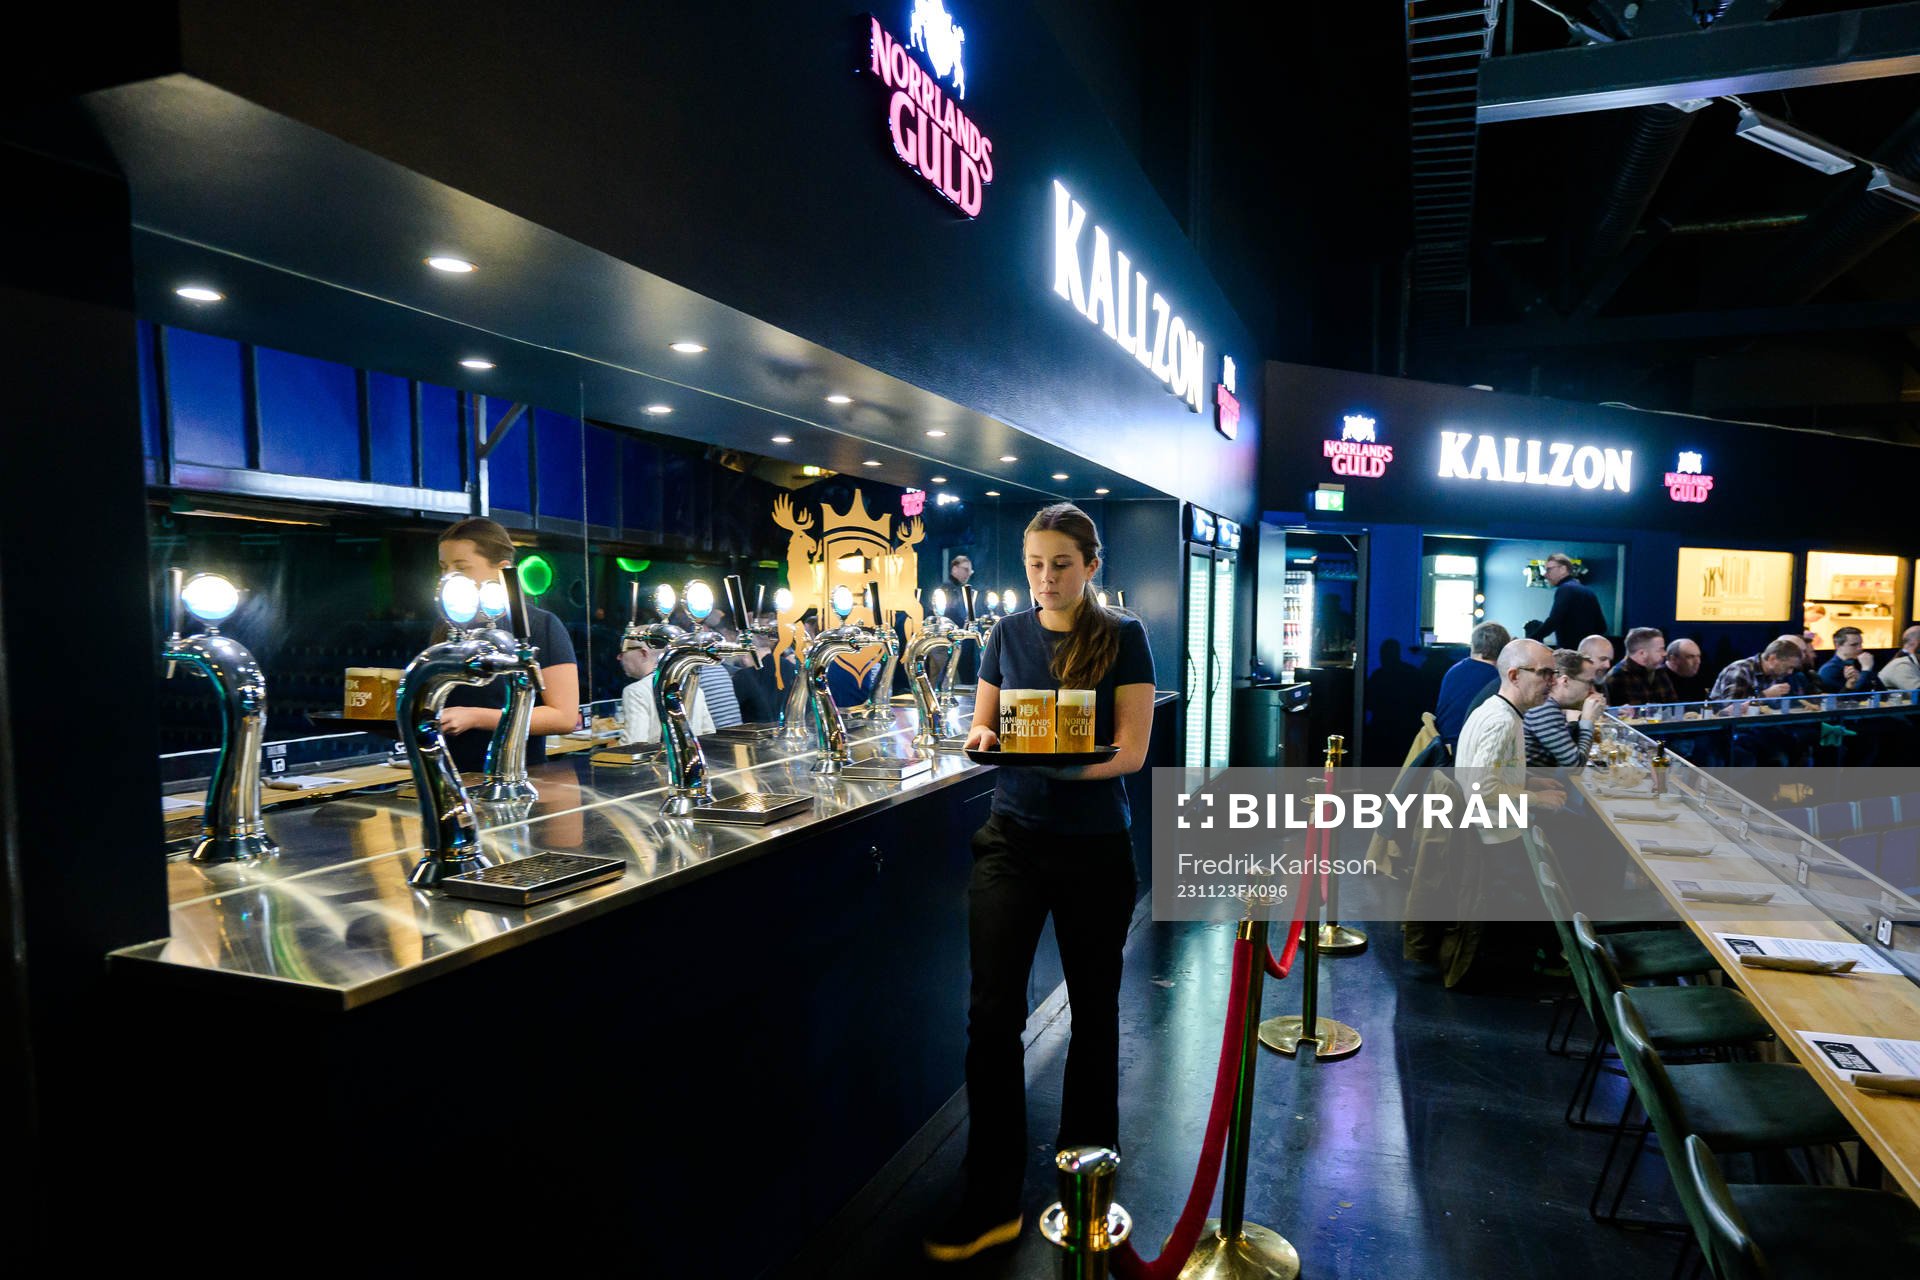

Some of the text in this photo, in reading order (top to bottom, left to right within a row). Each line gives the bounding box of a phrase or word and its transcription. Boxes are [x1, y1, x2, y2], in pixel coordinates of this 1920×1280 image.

[871, 16, 994, 183] NORRLANDS
[889, 90, 983, 217] GULD
[1053, 179, 1204, 414] KALLZON
[1323, 439, 1393, 463] NORRLANDS
[1331, 454, 1386, 478] GULD
[1438, 430, 1634, 492] KALLZON
[1669, 484, 1708, 503] GULD
[1016, 725, 1048, 737] GULD
